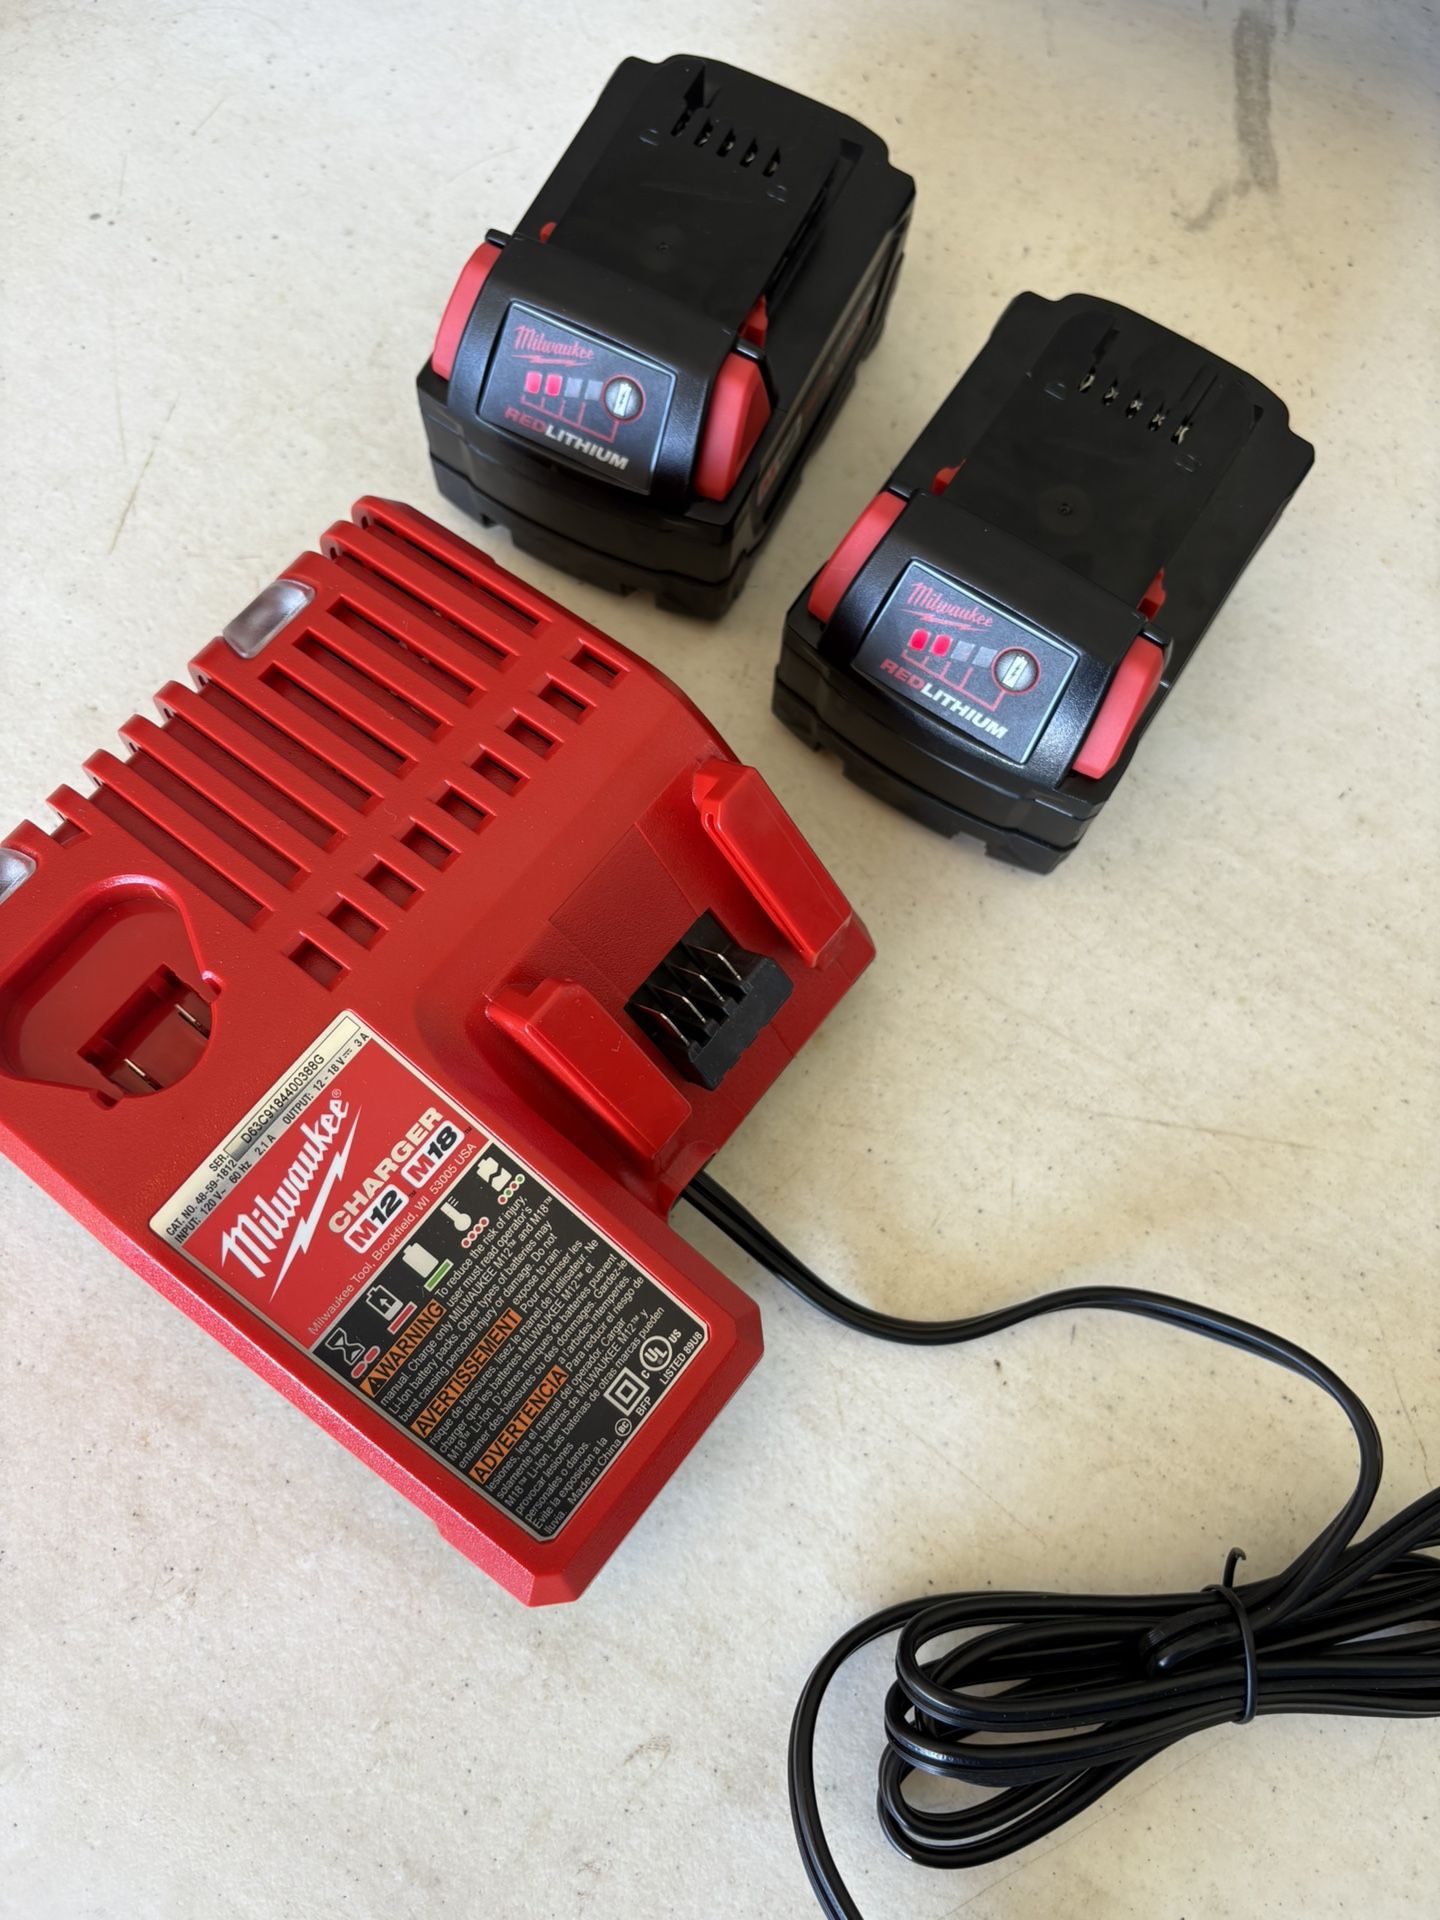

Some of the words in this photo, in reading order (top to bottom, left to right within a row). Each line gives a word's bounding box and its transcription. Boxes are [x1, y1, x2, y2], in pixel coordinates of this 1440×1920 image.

[513, 324, 595, 360] Milwaukee
[504, 405, 629, 470] REDLITHIUM
[906, 581, 994, 628] Milwaukee
[879, 658, 1008, 739] REDLITHIUM
[173, 1215, 201, 1244] INPUT:
[199, 1197, 217, 1215] 120
[227, 1169, 242, 1184] 60
[237, 1159, 253, 1174] Hz
[265, 1132, 277, 1144] A
[281, 1091, 314, 1125] OUTPUT:
[311, 1078, 326, 1092] 12
[326, 1062, 340, 1076] 18
[207, 1151, 229, 1172] SER.
[239, 1053, 325, 1145] D63C9184400388G
[164, 1216, 185, 1237] CAT.
[180, 1202, 198, 1220] NO.
[193, 1158, 238, 1205] 48-59-1812
[326, 1105, 444, 1235] CHARGER
[306, 1282, 355, 1335] Milwaukee
[349, 1259, 376, 1285] Tool,
[370, 1209, 419, 1262] Brookfield,
[413, 1194, 430, 1212] WI
[427, 1162, 458, 1195] 53005
[453, 1141, 477, 1166] USA
[433, 1285, 449, 1299] To
[444, 1256, 473, 1289] reduce
[468, 1242, 485, 1259] the
[481, 1226, 499, 1245] risk
[494, 1215, 507, 1230] of
[501, 1193, 528, 1221] injury,
[445, 1285, 465, 1308] user
[461, 1264, 483, 1289] must
[478, 1243, 499, 1268] read
[511, 1273, 541, 1308] expose
[534, 1263, 547, 1276] to
[542, 1245, 562, 1267] rain.
[519, 1289, 541, 1314] Pour
[536, 1251, 572, 1293] minimiser
[567, 1238, 583, 1255] les
[373, 1300, 445, 1381] WARNING
[378, 1370, 412, 1407] manual.
[406, 1338, 439, 1373] Charge
[433, 1319, 455, 1342] only
[447, 1265, 498, 1323] MILWAUKEE
[515, 1221, 534, 1242] and
[397, 1396, 422, 1423] burst
[416, 1364, 450, 1401] causing
[443, 1327, 479, 1369] personal
[472, 1304, 499, 1332] injury
[493, 1295, 505, 1308] or
[501, 1260, 536, 1299] damage.
[529, 1246, 546, 1262] Do
[541, 1231, 557, 1249] not
[408, 1357, 440, 1391] battery
[432, 1328, 462, 1362] packs.
[455, 1304, 481, 1332] Other
[476, 1282, 501, 1309] types
[495, 1271, 508, 1285] of
[502, 1237, 537, 1276] batteries
[533, 1219, 553, 1242] may
[427, 1416, 455, 1447] risque
[449, 1404, 464, 1419] de
[458, 1363, 499, 1408] blessures,
[493, 1341, 515, 1365] lisez
[509, 1332, 522, 1345] le
[538, 1294, 553, 1310] de
[583, 1237, 599, 1254] Ne
[520, 1332, 555, 1372] marques
[549, 1320, 563, 1335] de
[557, 1284, 591, 1323] batteries
[564, 1349, 586, 1372] Para
[581, 1319, 608, 1352] reducir
[611, 1286, 636, 1315] riesgo
[631, 1274, 644, 1289] de
[587, 1273, 634, 1324] intemperies.
[413, 1308, 519, 1436] AVERTISSEMENT
[437, 1418, 471, 1456] charger
[464, 1402, 483, 1423] que
[476, 1387, 493, 1404] les
[487, 1351, 522, 1390] batteries
[517, 1297, 565, 1354] MILWAUKEE
[583, 1261, 595, 1274] et
[484, 1453, 521, 1493] lesiones,
[514, 1438, 531, 1455] lea
[526, 1427, 538, 1441] el
[533, 1396, 563, 1431] manual
[558, 1382, 574, 1400] del
[569, 1345, 606, 1388] operador.
[599, 1315, 629, 1350] Cargar
[487, 1412, 505, 1432] des
[499, 1372, 537, 1415] blessures
[533, 1361, 546, 1375] ou
[541, 1344, 559, 1363] des
[554, 1298, 598, 1349] dommages.
[547, 1432, 565, 1452] Las
[560, 1399, 591, 1435] baterias
[586, 1387, 601, 1402] de
[596, 1366, 618, 1390] otras
[614, 1336, 641, 1369] marcas
[636, 1305, 666, 1340] pueden
[634, 1394, 652, 1417] BFP
[658, 1351, 686, 1385] LISTED
[472, 1367, 567, 1482] ADVERTENCIA
[495, 1453, 533, 1500] solamente
[528, 1440, 544, 1456] las
[538, 1406, 570, 1443] baterias
[566, 1394, 580, 1409] de
[574, 1340, 622, 1397] MILWAUKEE
[514, 1475, 548, 1516] provocar
[541, 1440, 574, 1478] lesiones
[523, 1473, 564, 1524] personales
[531, 1504, 554, 1530] Evite
[548, 1495, 561, 1508] la
[595, 1435, 608, 1447] la
[566, 1475, 592, 1505] Made
[587, 1464, 600, 1478] in
[595, 1436, 622, 1467] China
